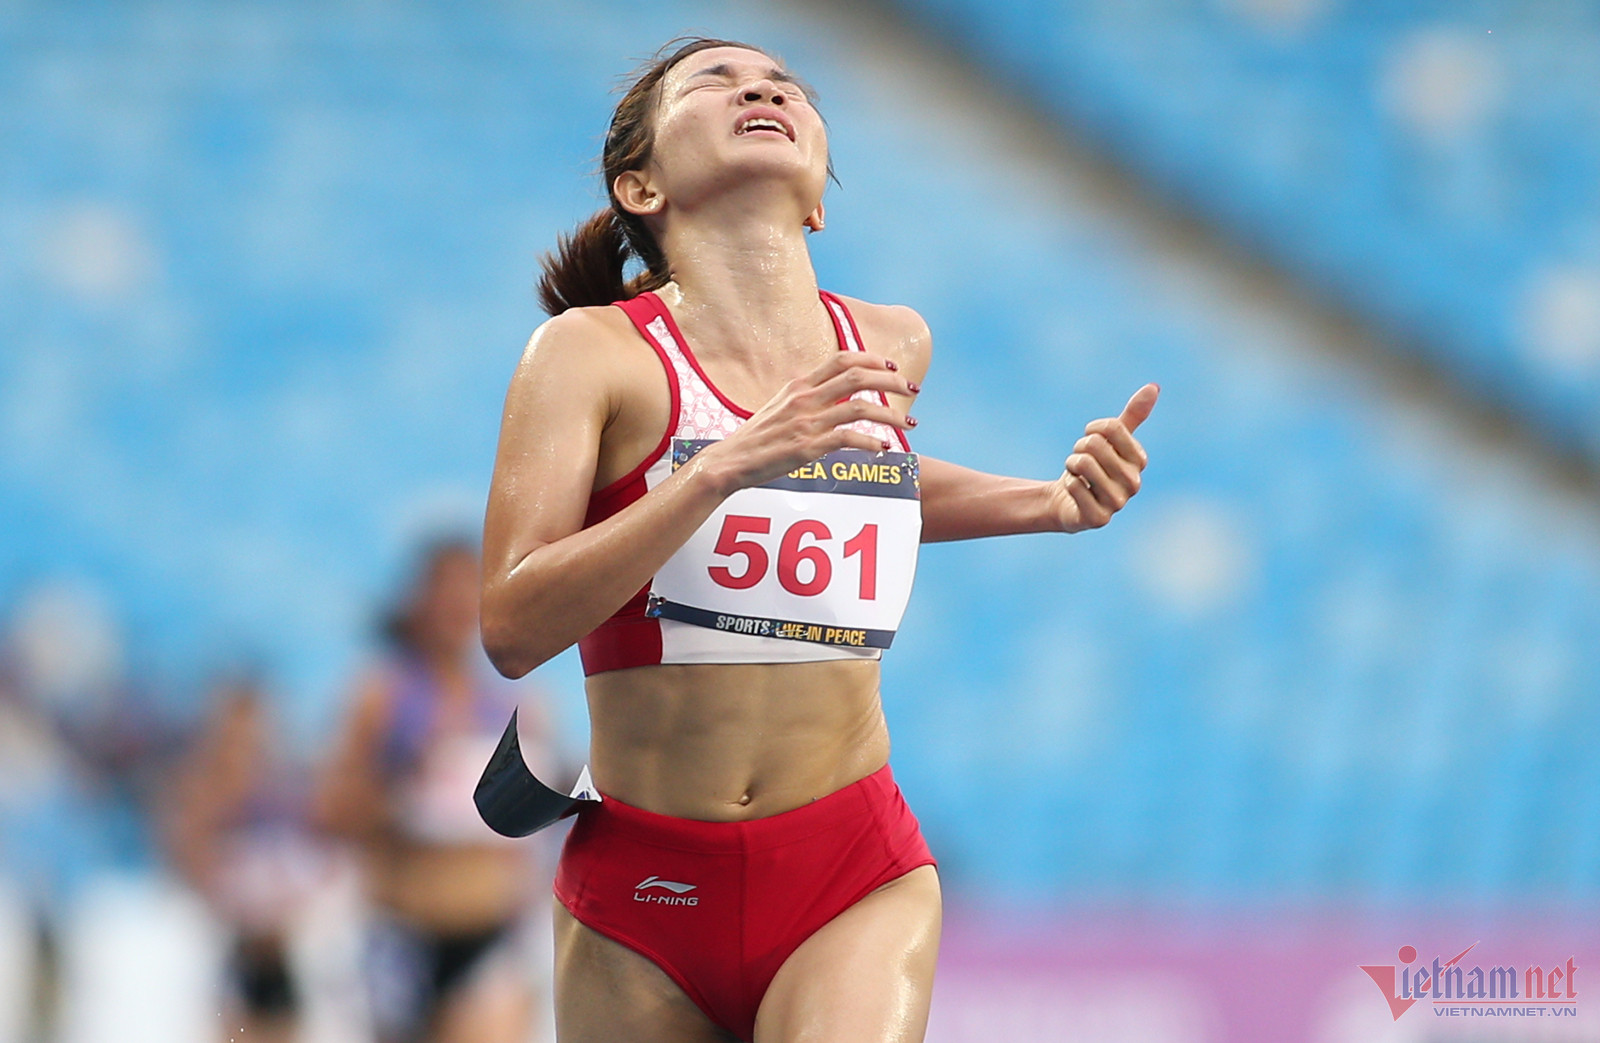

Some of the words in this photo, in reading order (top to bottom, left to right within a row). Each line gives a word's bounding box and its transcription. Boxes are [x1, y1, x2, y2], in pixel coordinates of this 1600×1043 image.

[831, 462, 901, 485] GAMES
[707, 514, 878, 601] 561
[716, 615, 770, 635] SPORTS
[806, 625, 822, 642] IN
[825, 628, 866, 646] PEACE
[633, 892, 699, 906] LI-NING
